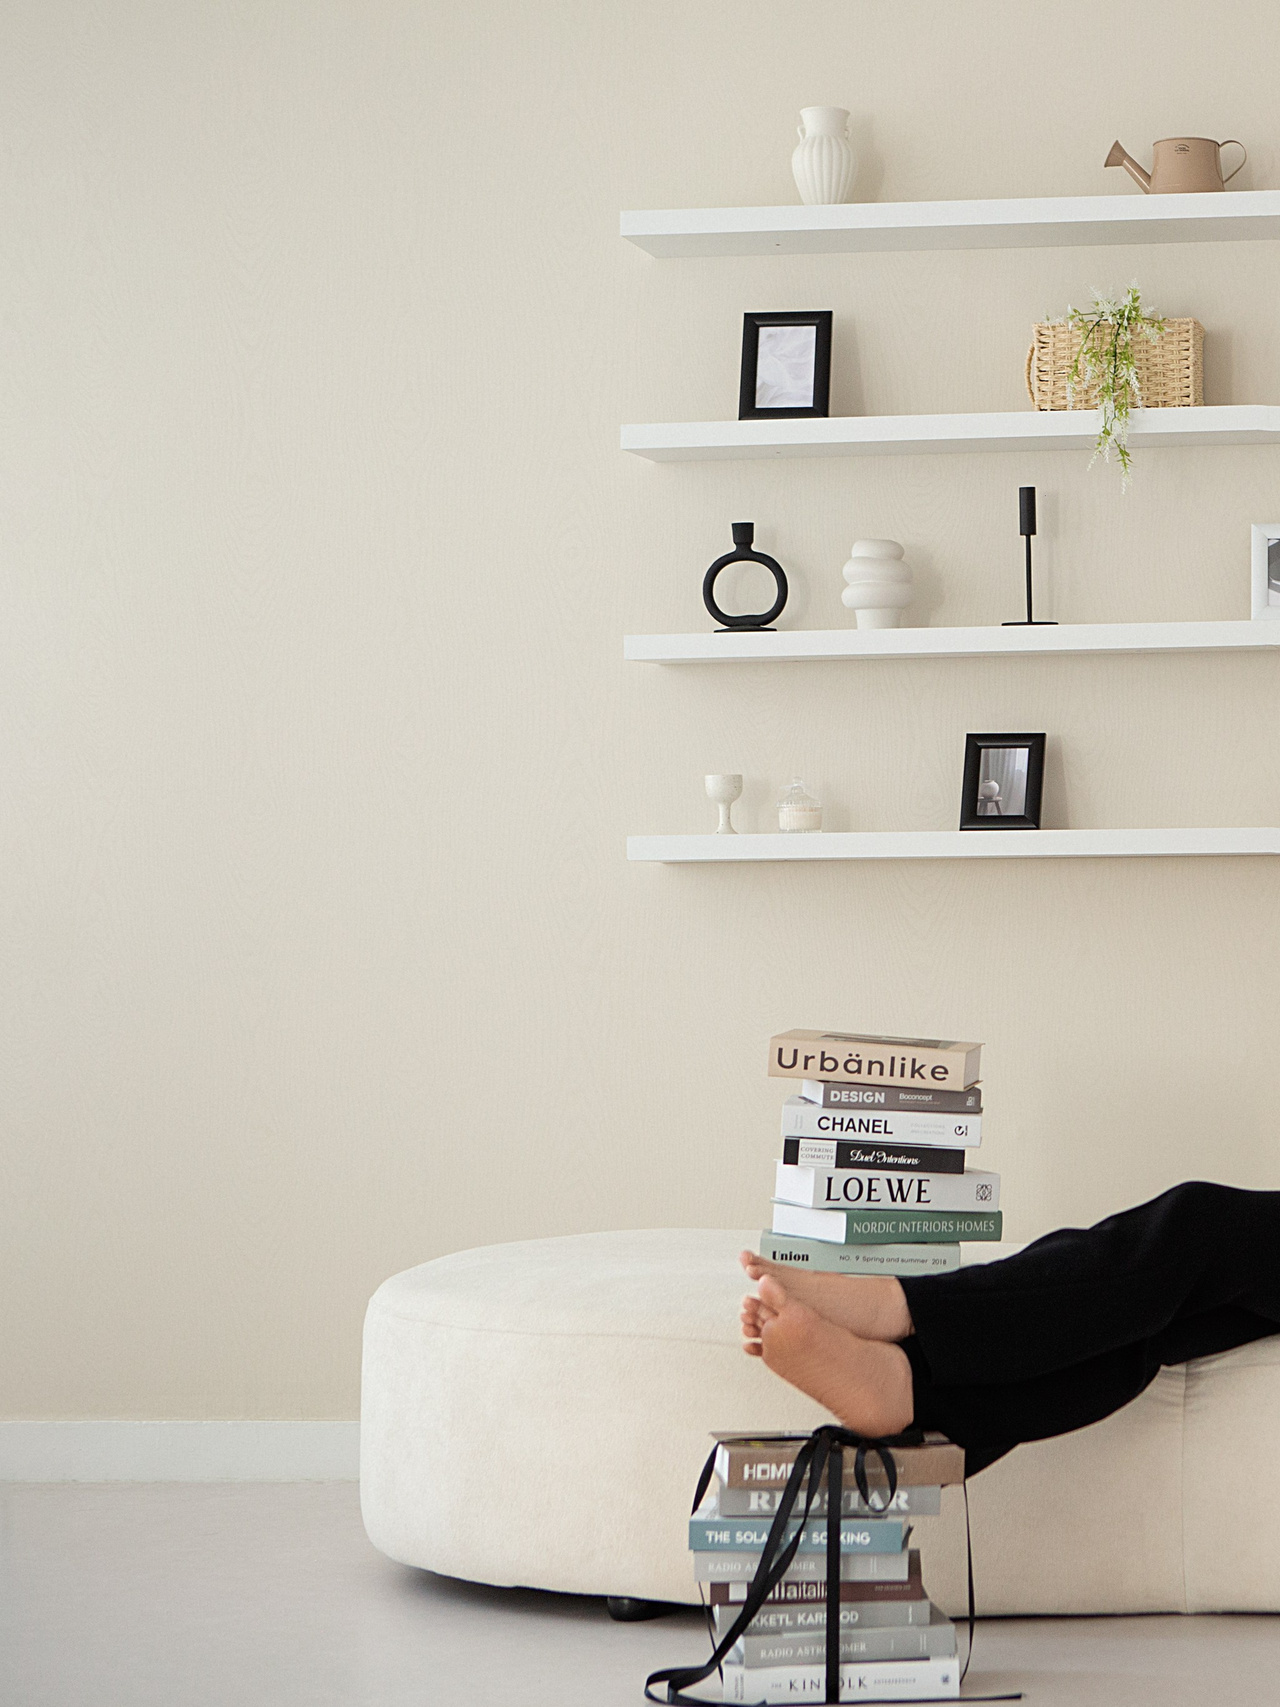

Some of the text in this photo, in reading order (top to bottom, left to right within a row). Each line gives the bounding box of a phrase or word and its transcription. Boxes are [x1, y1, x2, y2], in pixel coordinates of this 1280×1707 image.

[777, 1047, 949, 1081] Urbänlike
[829, 1090, 885, 1104] DESIGN
[817, 1115, 894, 1135] CHANEL
[800, 1146, 834, 1154] COVERING
[825, 1176, 932, 1204] LOEWE
[853, 1220, 995, 1234] NORDIC INTERIORS HOMES
[772, 1250, 810, 1262] Union
[862, 1255, 885, 1264] Spring
[743, 1462, 811, 1481] HOM
[748, 1489, 911, 1512] RDTAR
[706, 1530, 731, 1544] THE
[735, 1530, 785, 1545] SOLA
[811, 1531, 871, 1546] SOKING
[708, 1561, 817, 1573] RADIO ASMER
[748, 1613, 794, 1628] KKETL
[760, 1642, 867, 1659] RADIO ASTRMER
[789, 1676, 868, 1692] KINLK
